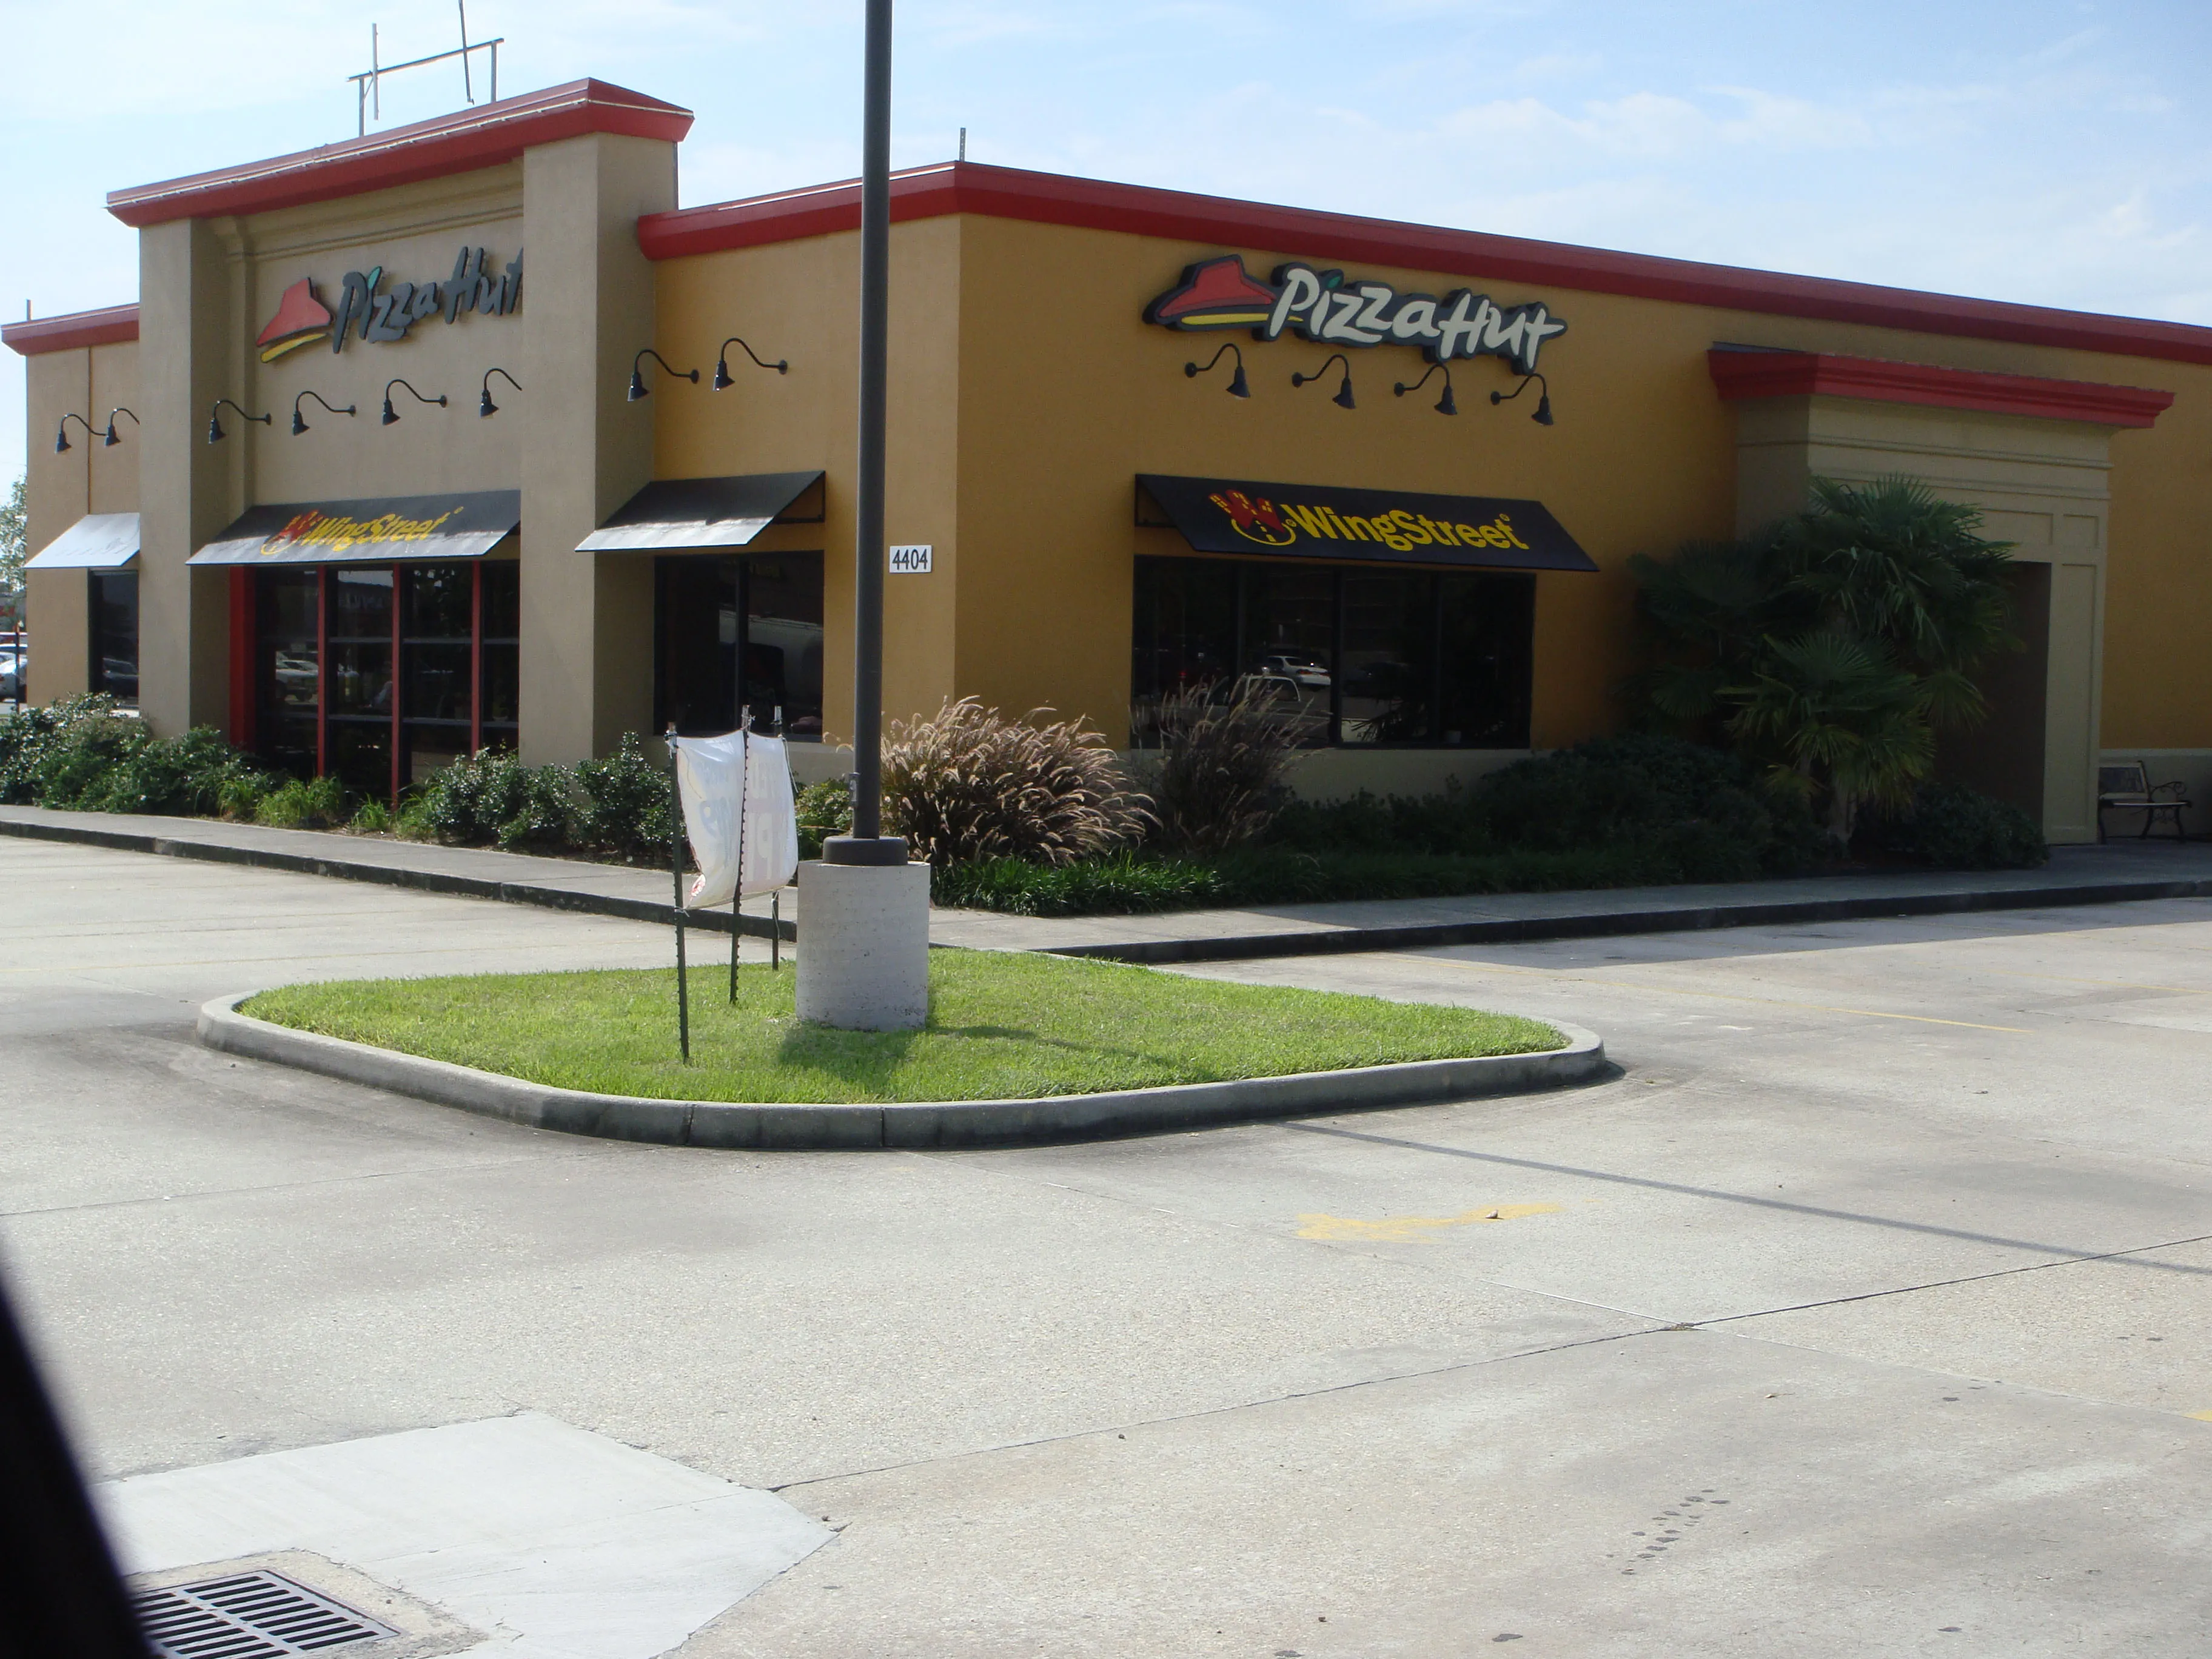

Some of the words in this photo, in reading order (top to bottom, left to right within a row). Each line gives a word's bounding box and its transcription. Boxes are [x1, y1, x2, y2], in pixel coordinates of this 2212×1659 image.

[1269, 267, 1440, 346] Pizza
[1436, 292, 1566, 370] Hut
[892, 548, 928, 571] 4404
